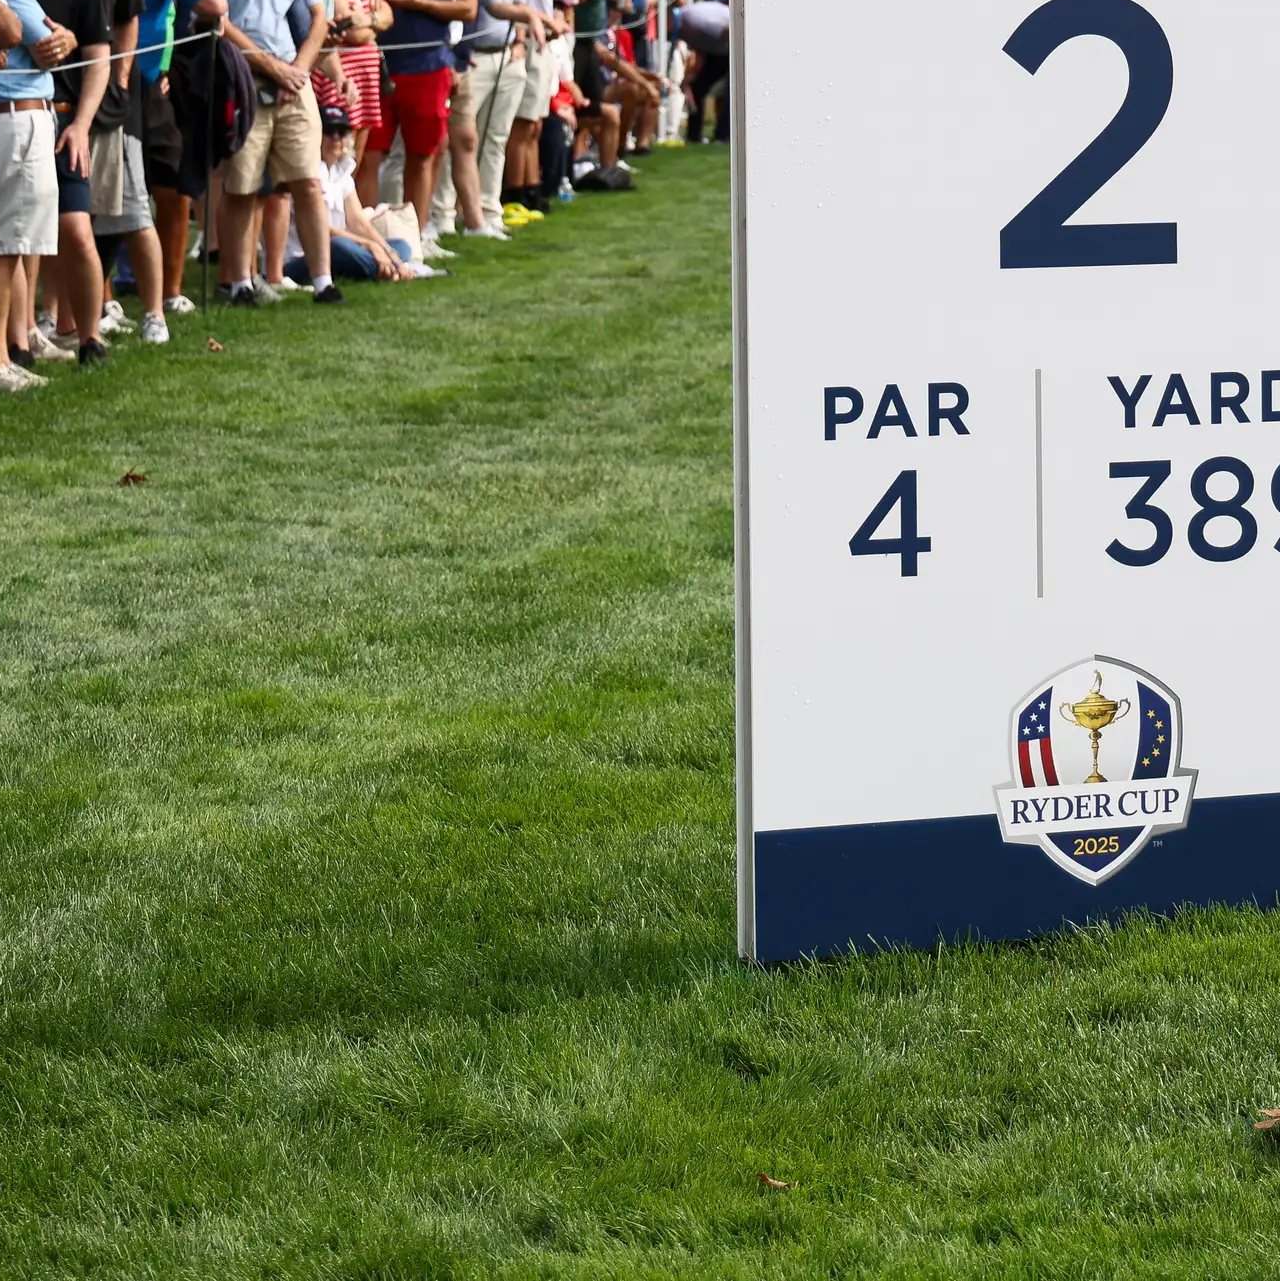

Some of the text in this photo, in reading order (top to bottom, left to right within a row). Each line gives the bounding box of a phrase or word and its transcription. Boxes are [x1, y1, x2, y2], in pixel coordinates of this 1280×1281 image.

[823, 381, 971, 442] PAR
[848, 469, 932, 578] 4
[1010, 788, 1180, 825] RYDER CUP
[1073, 835, 1120, 857] 2025
